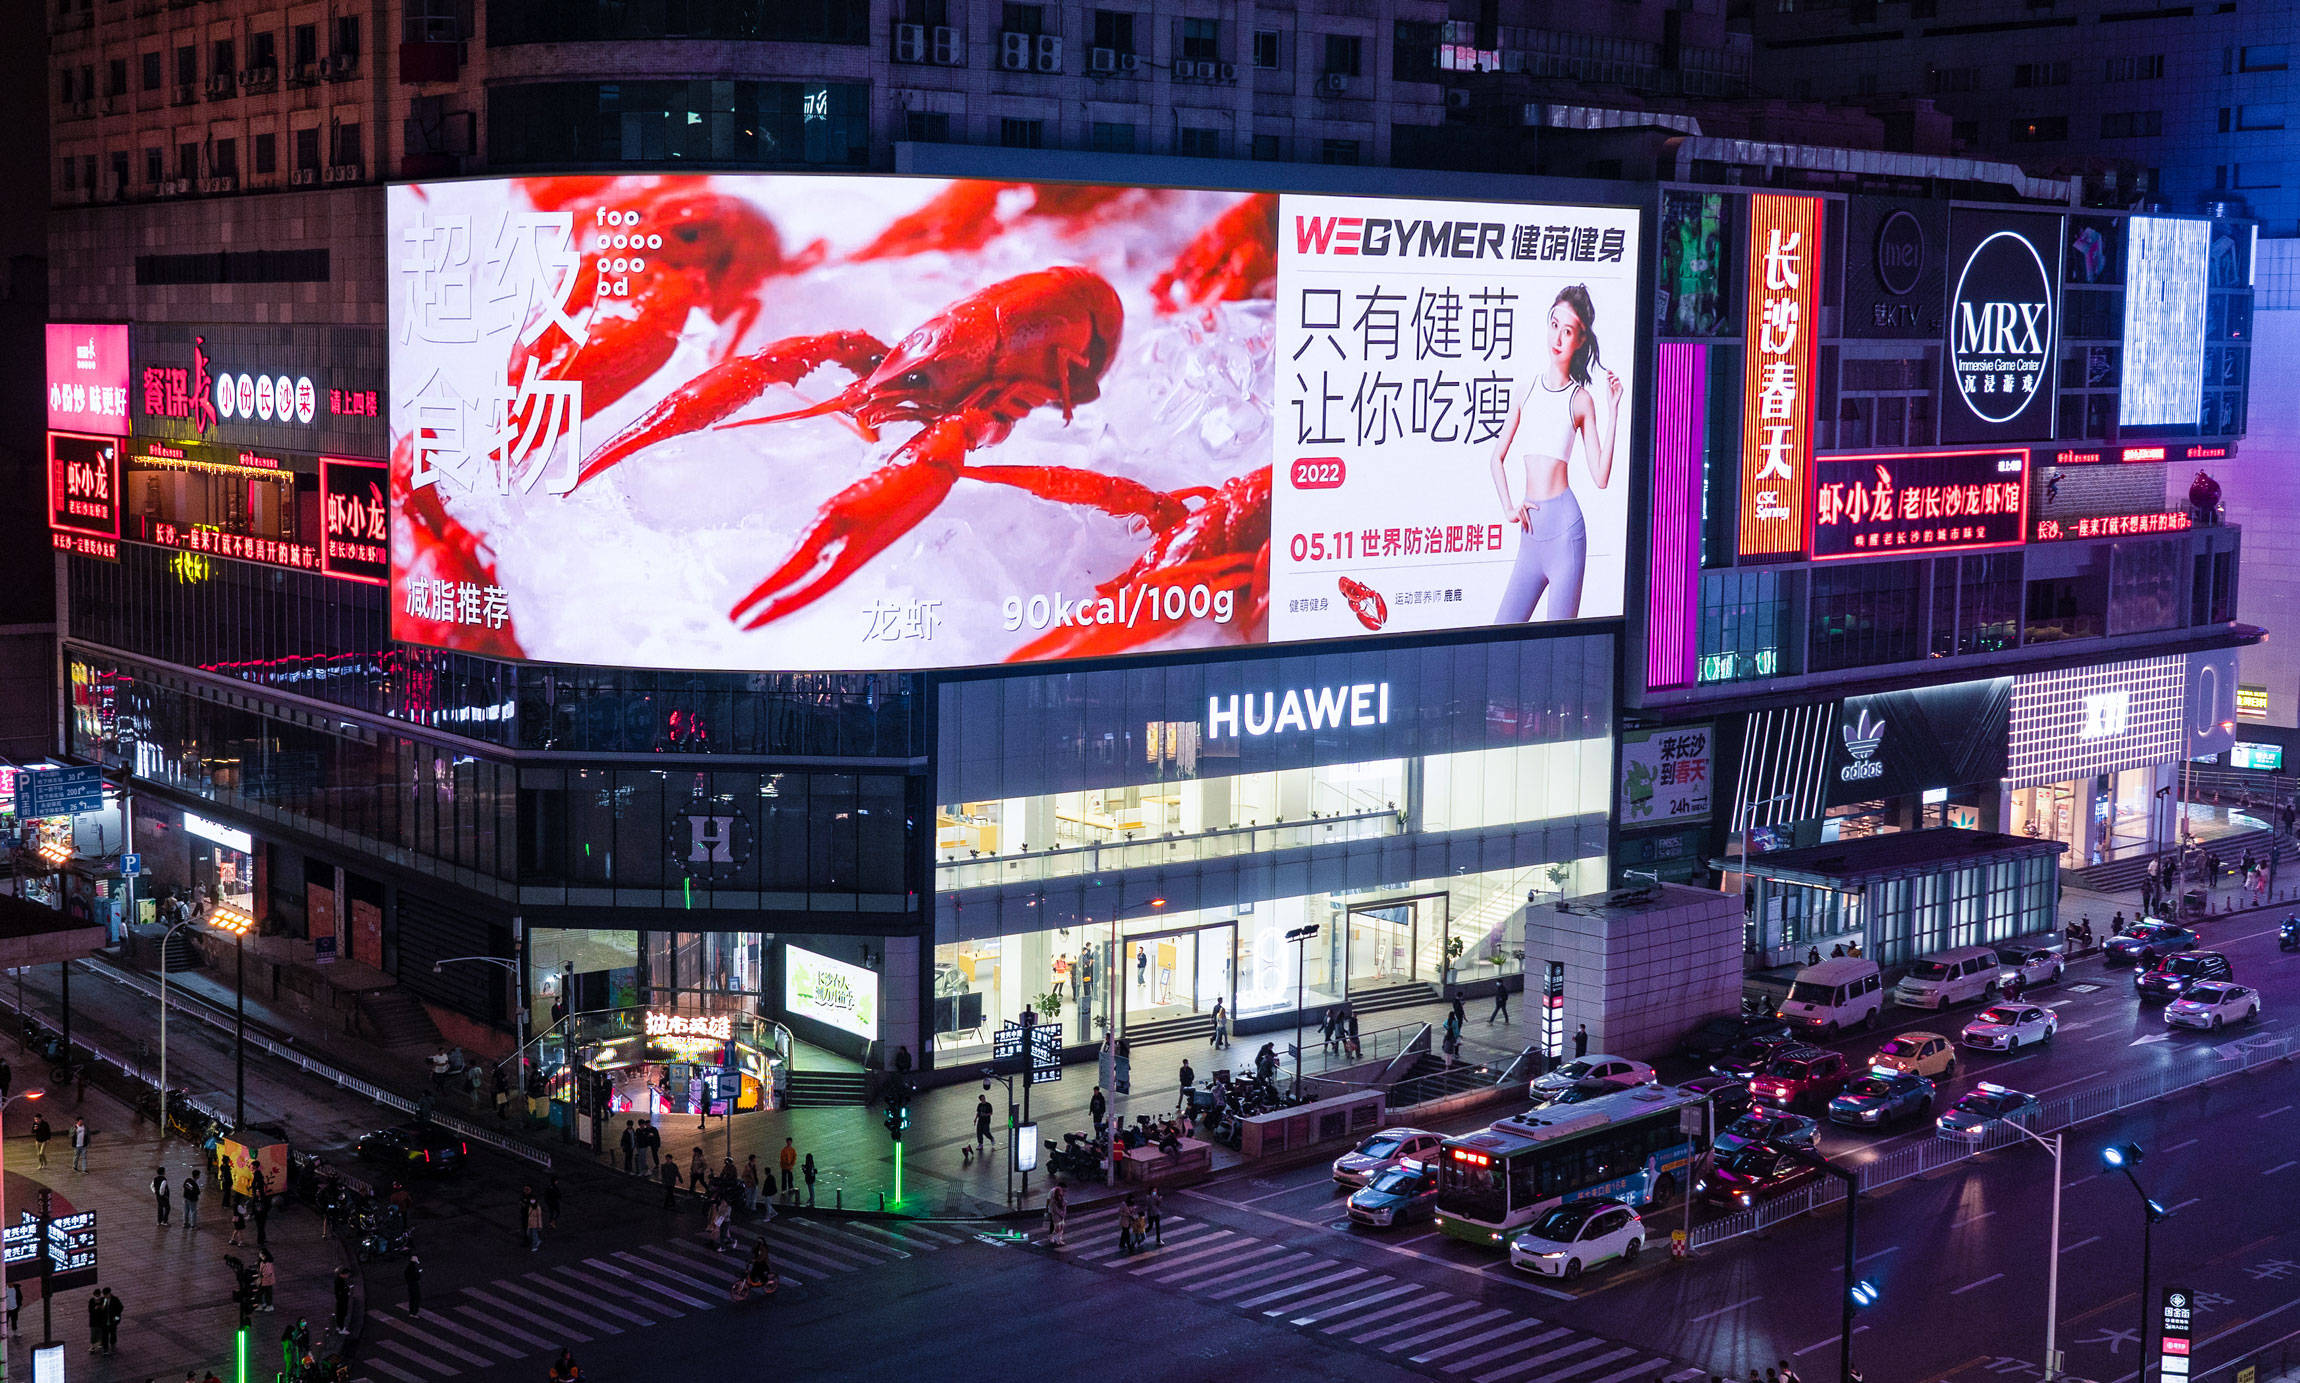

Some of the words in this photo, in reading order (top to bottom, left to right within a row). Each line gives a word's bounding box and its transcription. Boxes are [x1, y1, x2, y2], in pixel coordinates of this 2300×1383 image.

[596, 206, 640, 227] foo
[1295, 215, 1506, 261] WEGYMER
[1510, 222, 1626, 263] 健萌健身
[400, 209, 590, 350] 超级
[596, 256, 646, 274] ooo
[596, 277, 629, 297] od
[1291, 284, 1520, 362] 只有健萌
[1957, 302, 2047, 354] MRX
[1756, 229, 1801, 481] 长沙春天
[1959, 359, 1994, 372] Immersive
[1994, 358, 2016, 372] Game
[2017, 358, 2041, 372] Center
[219, 378, 314, 419] 小份长沙菜
[330, 389, 378, 417] 请上四楼
[1291, 369, 1512, 447] 让你吃瘦
[401, 355, 584, 498] 食物
[67, 461, 108, 499] 虾小龙
[1296, 463, 1341, 485] 2022
[327, 492, 387, 540] 虾小龙
[1818, 481, 1893, 526] 虾小龙
[1289, 531, 1355, 562] 05.11
[1360, 523, 1504, 558] 世界防治肥胖日
[405, 575, 510, 630] 减脂推荐
[861, 598, 944, 643] 龙虾
[1002, 582, 1235, 632] 90kcal/100g
[1208, 682, 1389, 739] HUAWEI
[19, 774, 31, 792] P
[1841, 760, 1883, 782] adidas
[1670, 797, 1691, 815] 24h
[124, 855, 137, 873] P
[645, 1010, 731, 1040] 城市英雄
